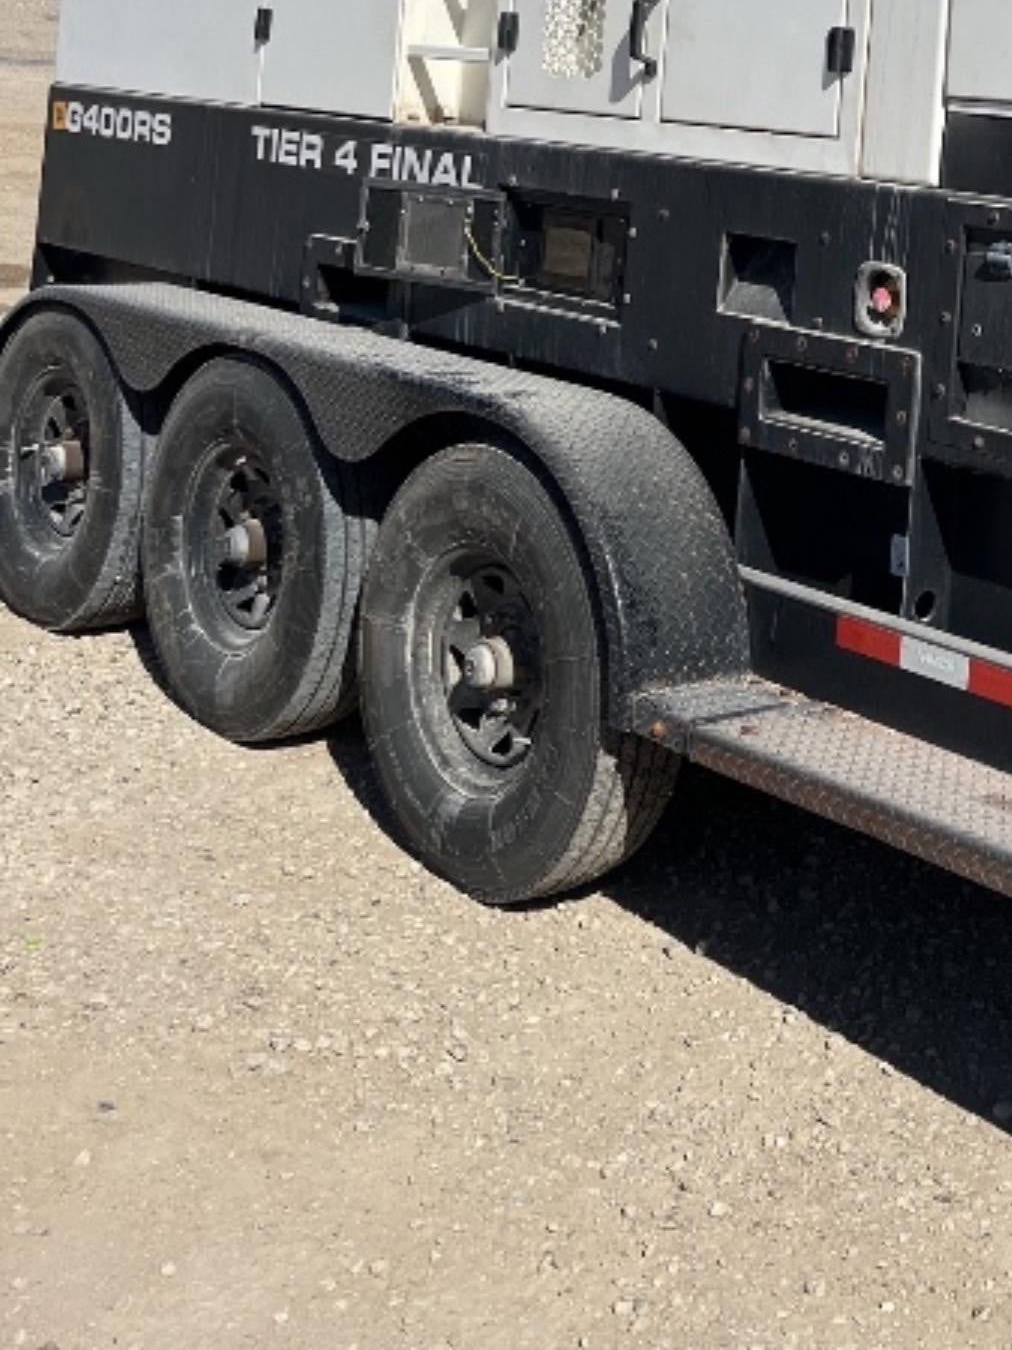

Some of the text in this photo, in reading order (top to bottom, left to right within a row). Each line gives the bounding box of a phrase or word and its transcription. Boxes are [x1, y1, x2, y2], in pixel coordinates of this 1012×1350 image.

[67, 100, 172, 146] G400RS
[251, 124, 483, 190] TIER 4 FINAL
